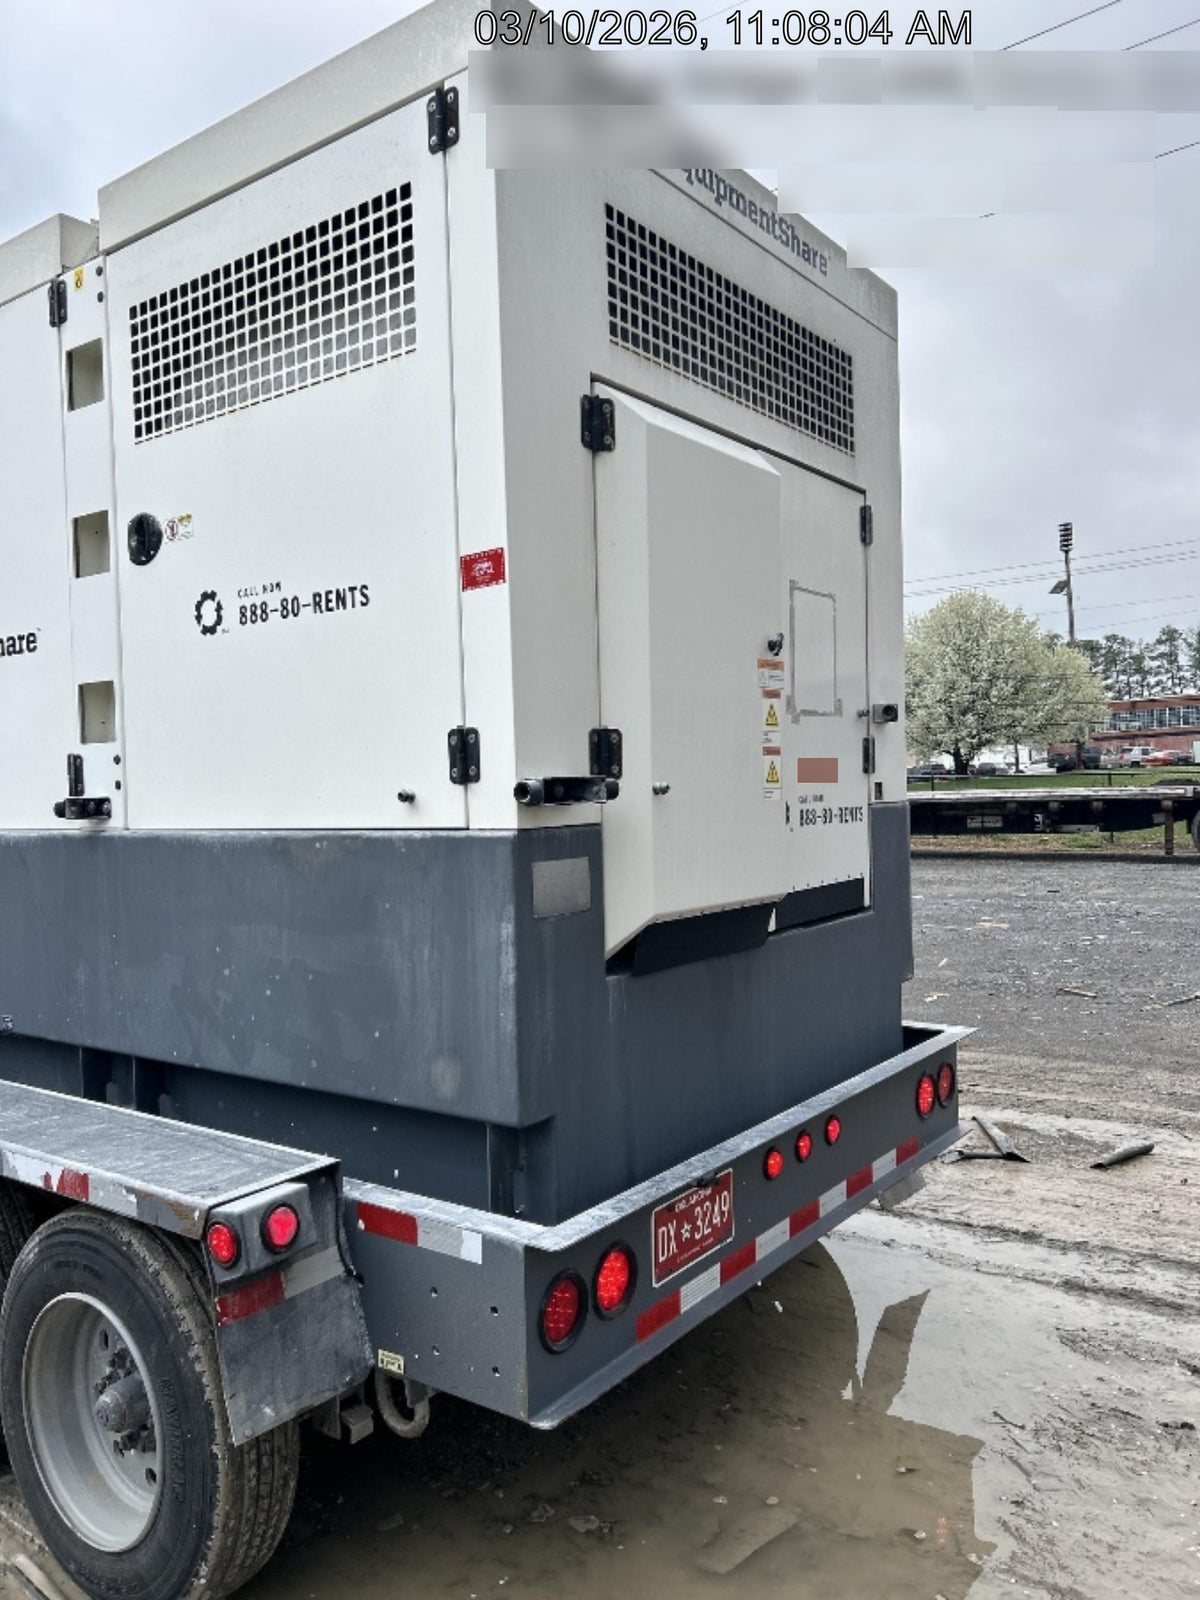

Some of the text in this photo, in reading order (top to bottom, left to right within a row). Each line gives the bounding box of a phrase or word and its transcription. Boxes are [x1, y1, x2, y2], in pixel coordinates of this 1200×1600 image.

[238, 584, 370, 626] 888-80-RENTS
[658, 1219, 679, 1263] DX
[694, 1190, 731, 1240] 3249
